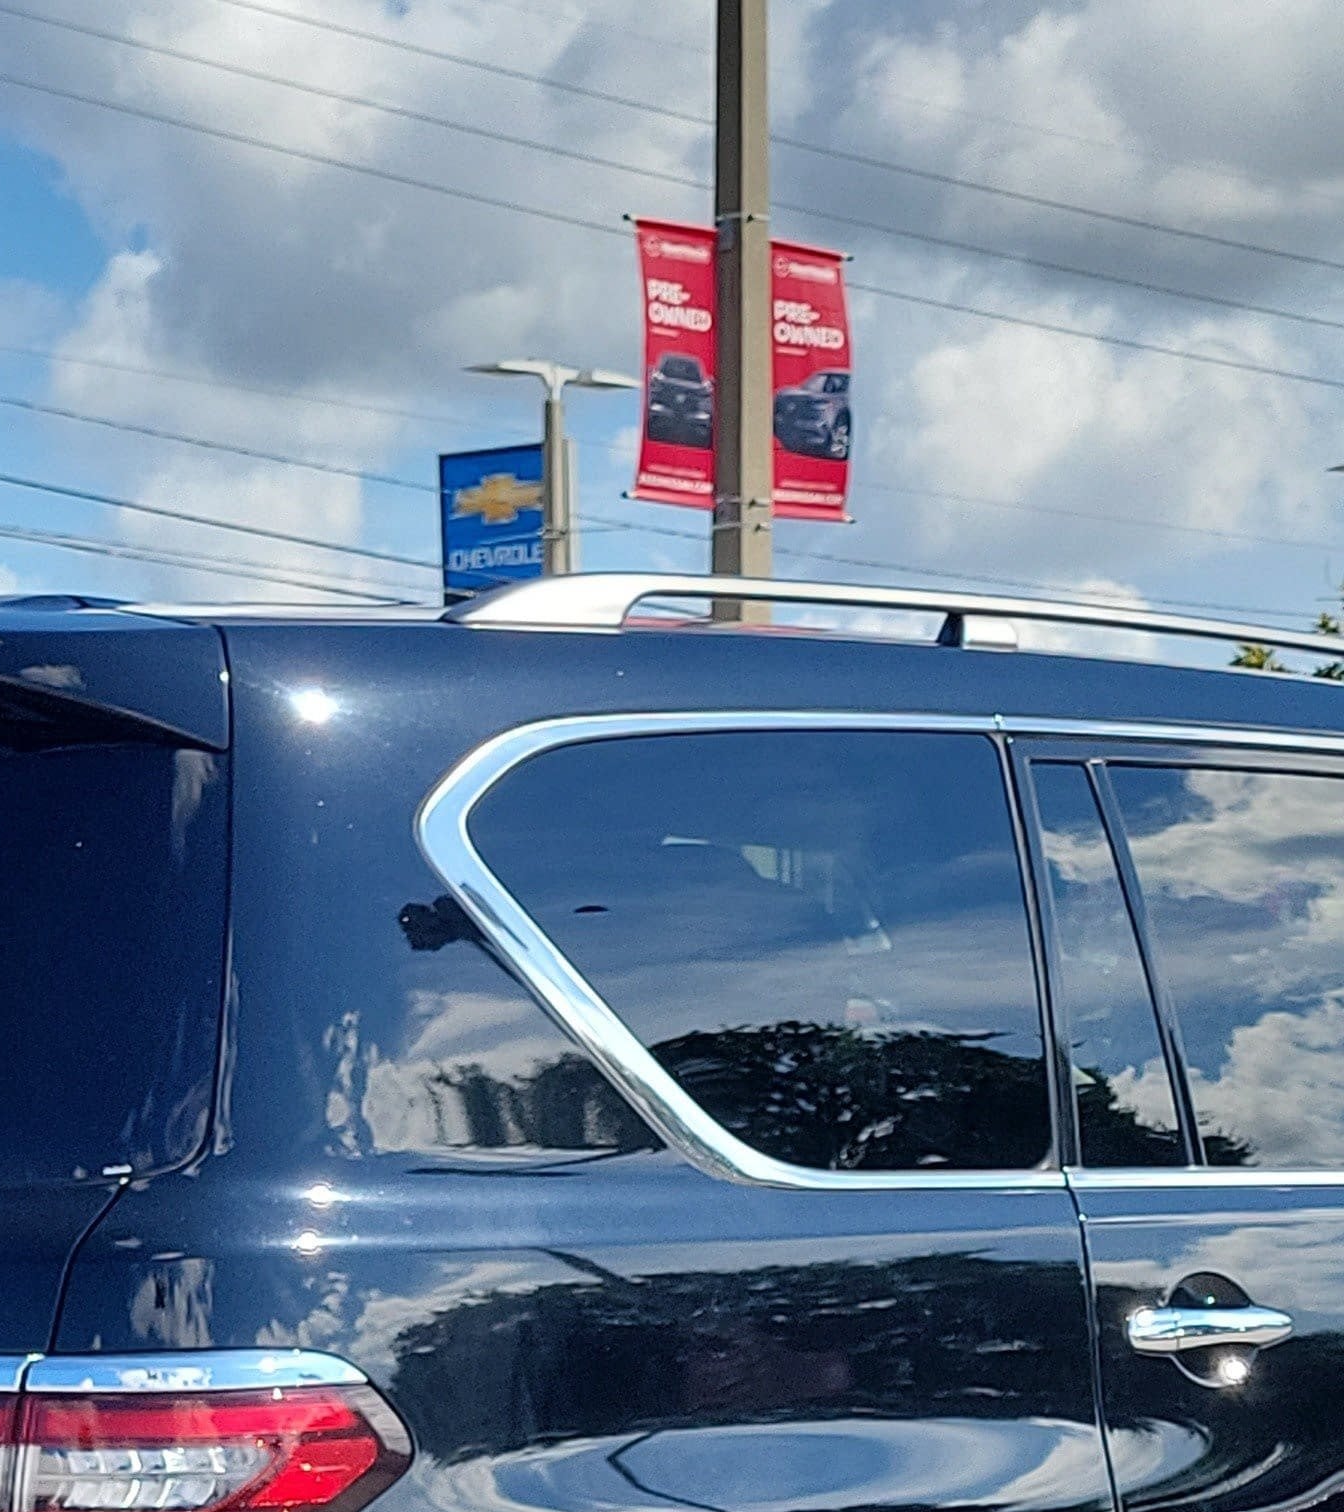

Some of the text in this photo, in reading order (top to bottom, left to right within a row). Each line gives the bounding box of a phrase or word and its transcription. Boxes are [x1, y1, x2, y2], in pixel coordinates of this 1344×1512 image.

[648, 301, 712, 332] OWNED
[773, 321, 844, 350] OWNED
[449, 542, 544, 571] CHEVROLE
